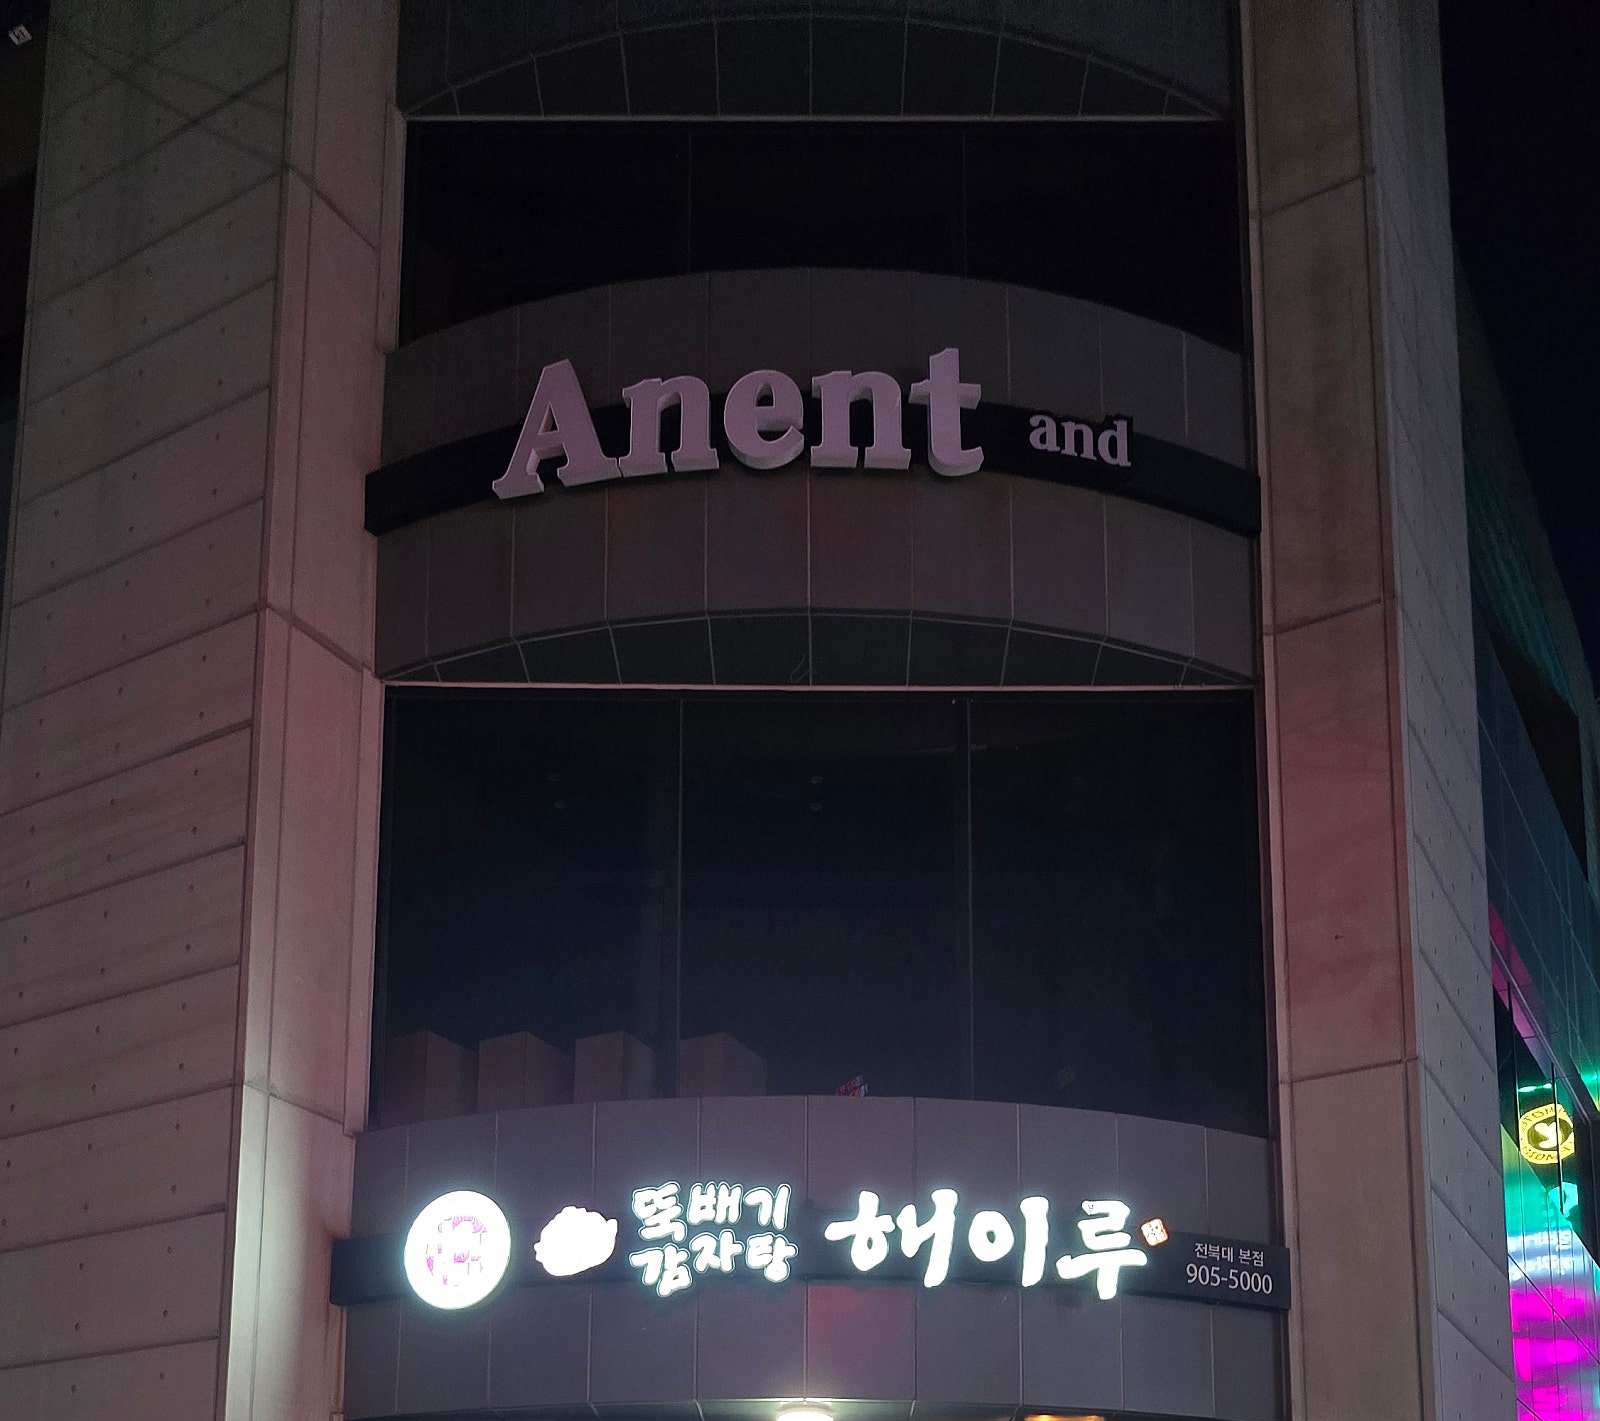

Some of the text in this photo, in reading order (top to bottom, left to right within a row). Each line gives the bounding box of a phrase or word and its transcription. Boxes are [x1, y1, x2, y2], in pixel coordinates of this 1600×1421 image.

[492, 347, 1131, 500] Anent and
[632, 1181, 792, 1243] 뚝배기
[824, 1188, 1148, 1300] 해이루
[629, 1229, 799, 1297] 감자탕
[1186, 1263, 1273, 1294] 905-5000
[1194, 1242, 1264, 1267] 전북대 본점
